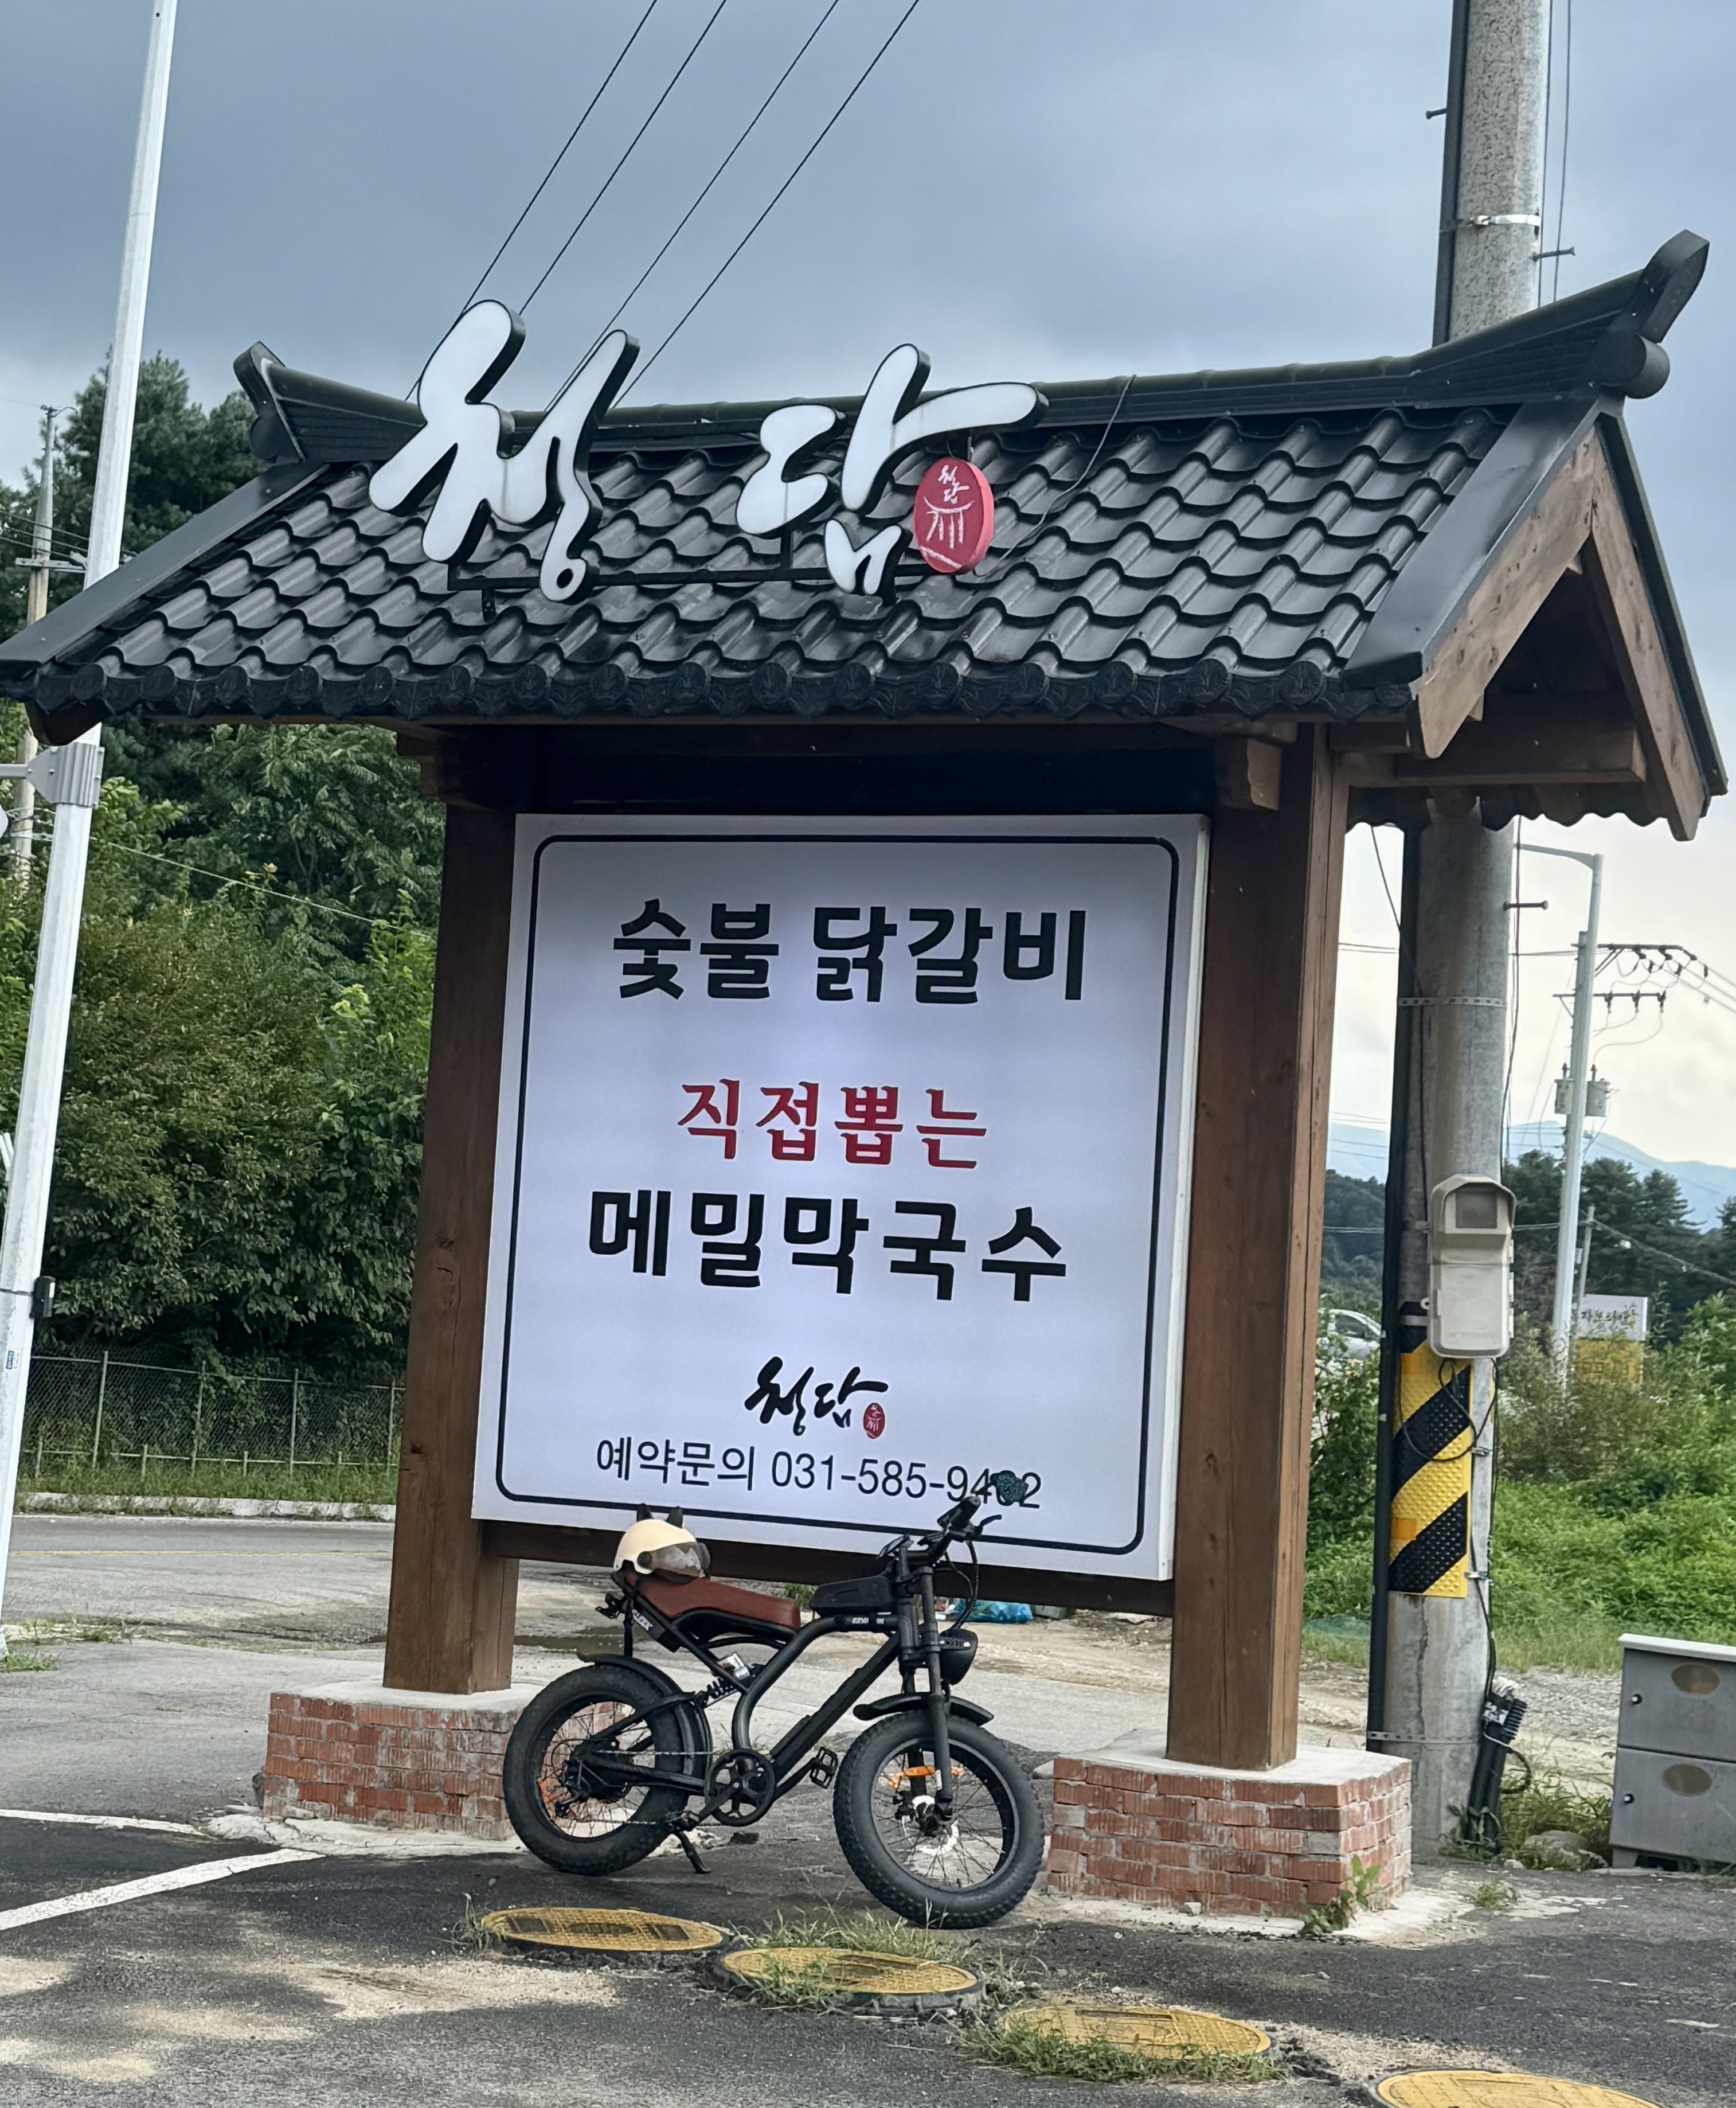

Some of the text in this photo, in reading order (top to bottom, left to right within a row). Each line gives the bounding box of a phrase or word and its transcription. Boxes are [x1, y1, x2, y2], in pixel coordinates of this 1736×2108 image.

[613, 898, 1086, 1004] 숯불 닭갈비
[677, 1079, 987, 1169] 직접뽑는
[589, 1190, 1066, 1302] 메밀막국수
[744, 1356, 889, 1436] 청담
[597, 1437, 754, 1490] 예약문의
